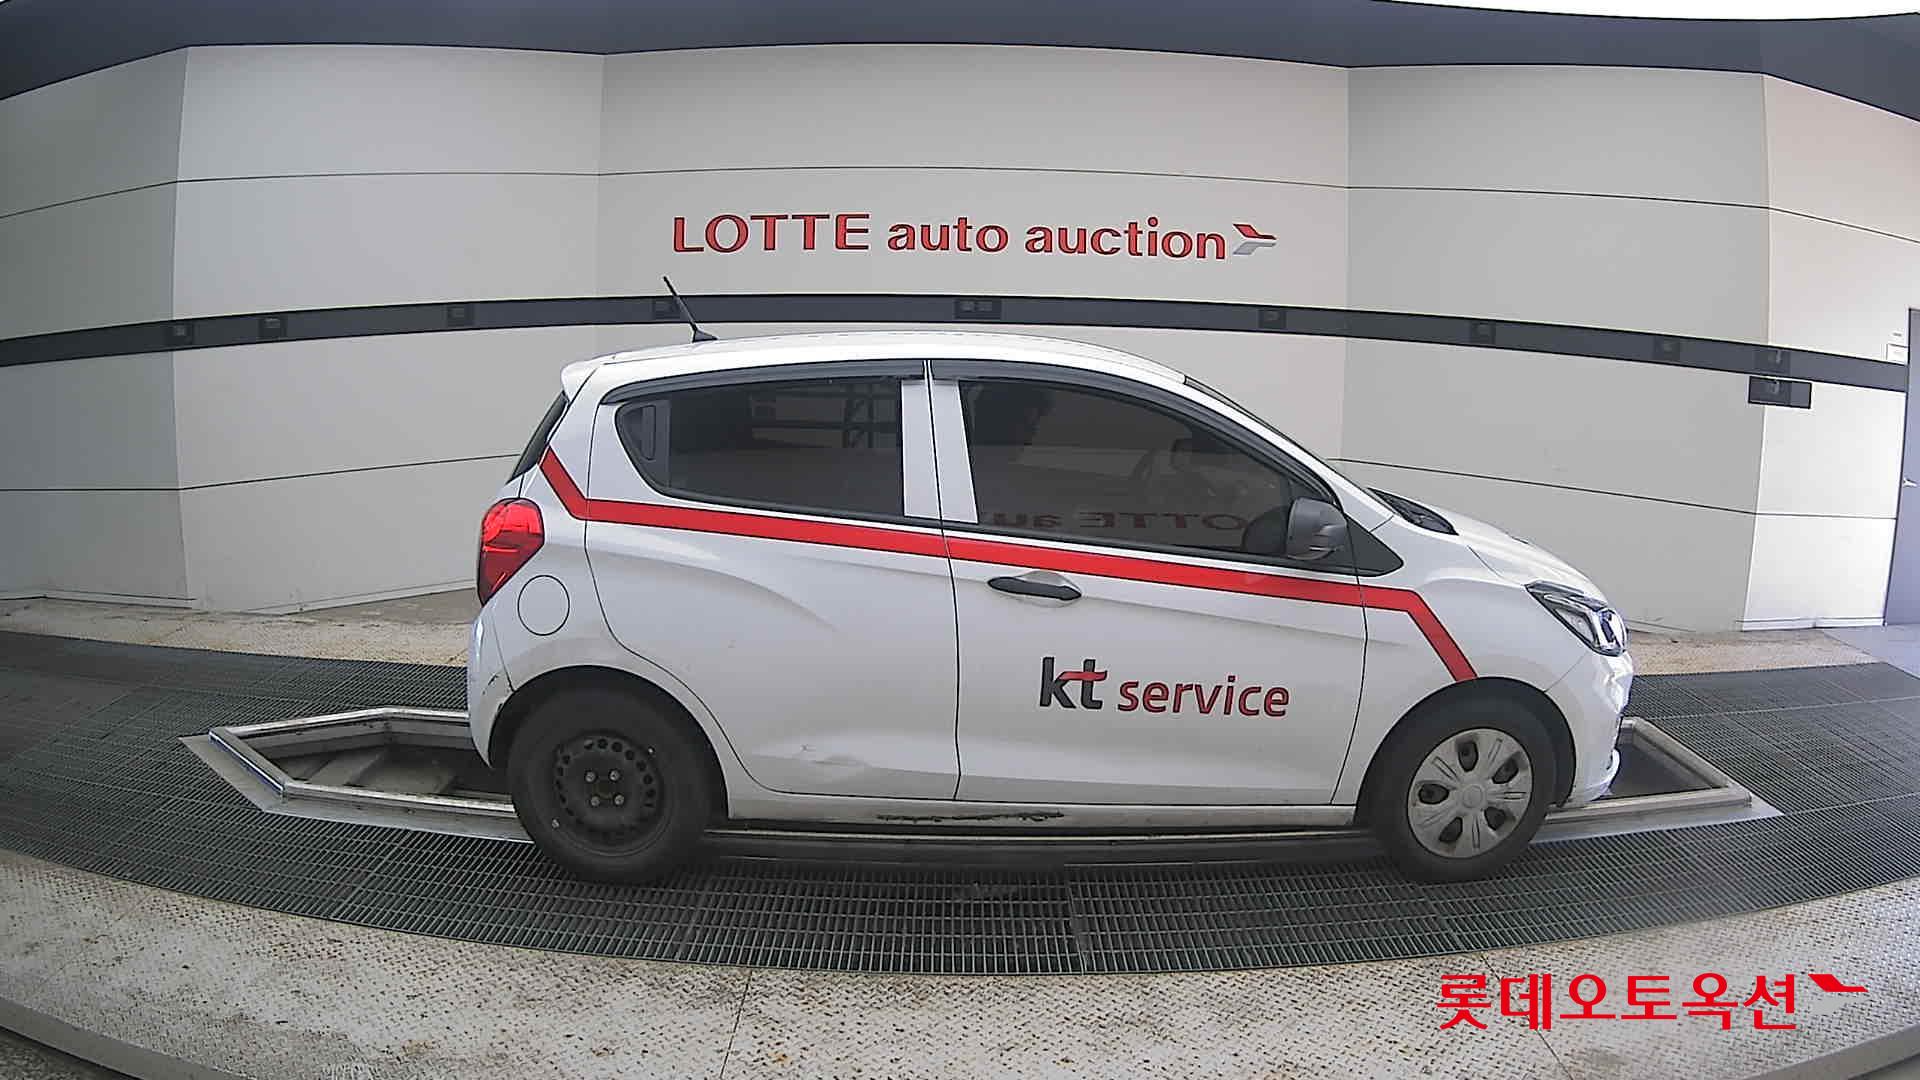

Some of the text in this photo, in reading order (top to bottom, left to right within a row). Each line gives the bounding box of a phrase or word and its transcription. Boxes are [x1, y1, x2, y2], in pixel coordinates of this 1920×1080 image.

[673, 213, 1227, 260] LOTTE auto auction
[1039, 656, 1290, 717] kt service
